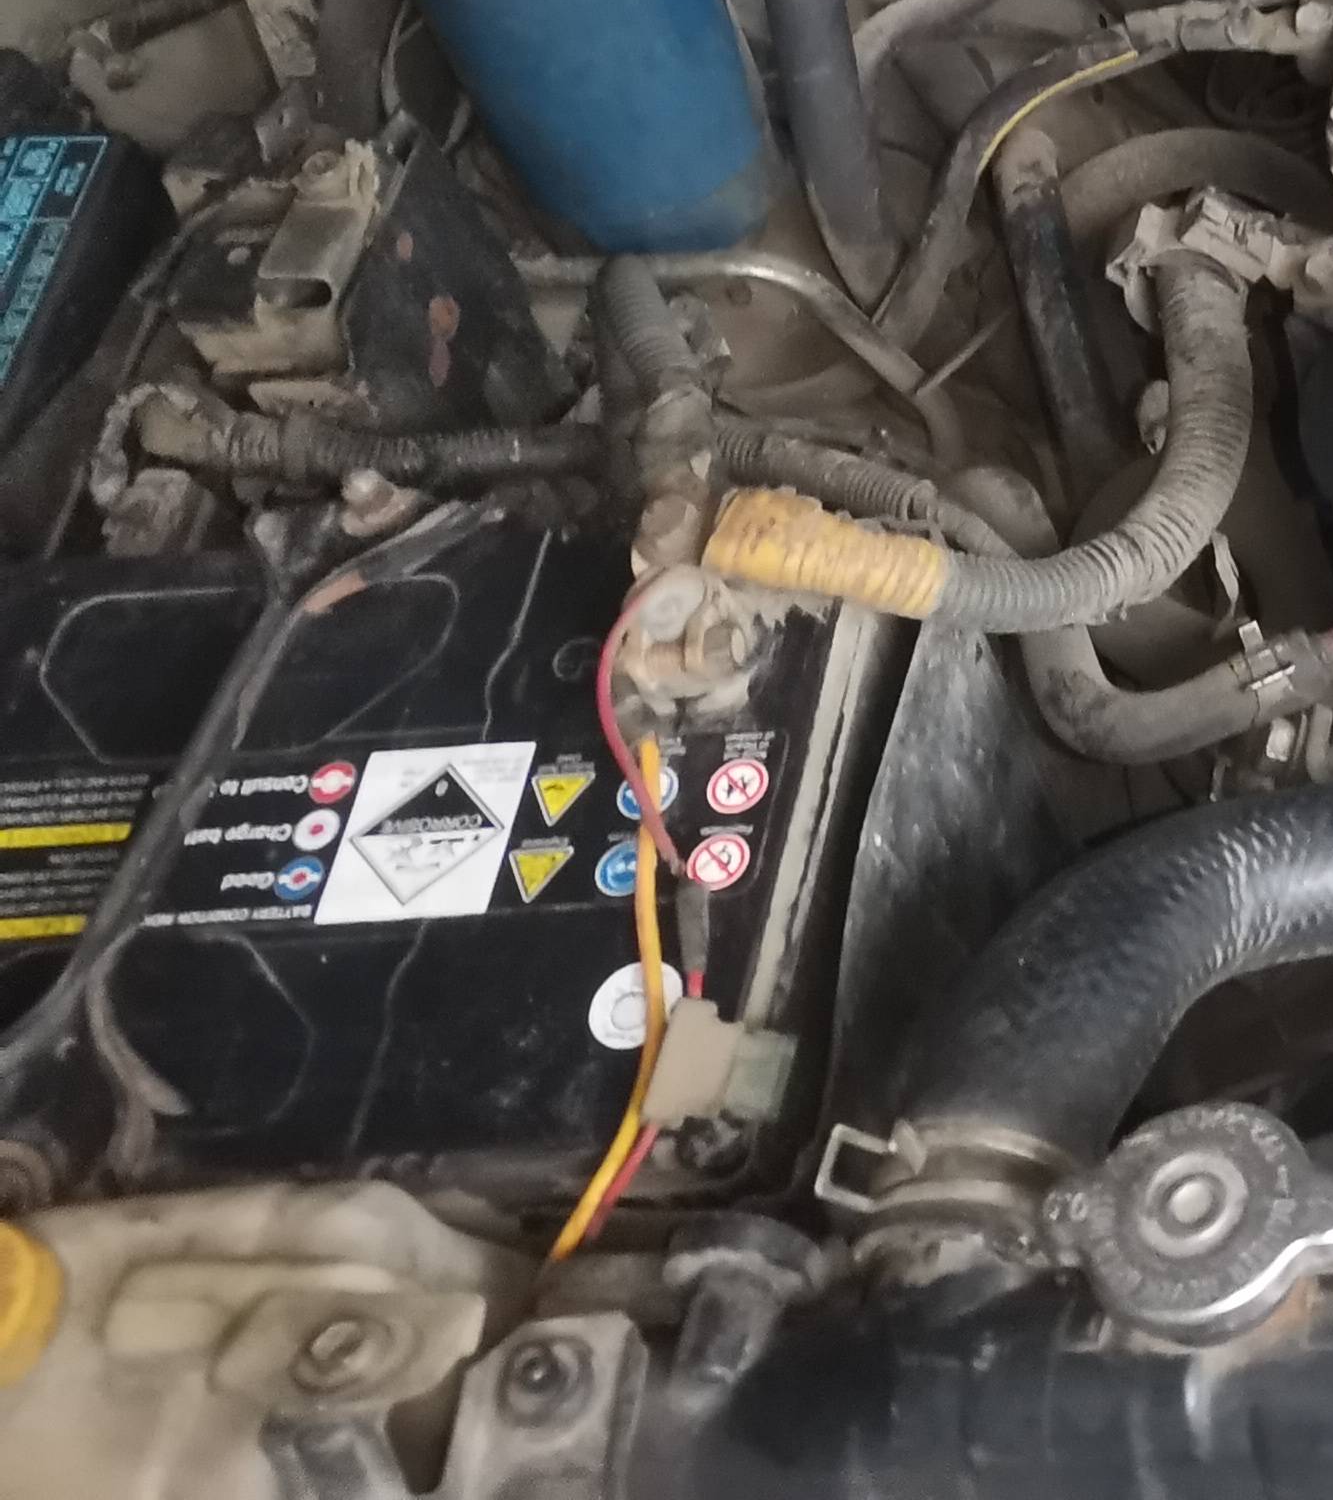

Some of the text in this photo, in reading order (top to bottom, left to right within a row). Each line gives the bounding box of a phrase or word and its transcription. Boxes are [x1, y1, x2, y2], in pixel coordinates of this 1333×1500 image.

[240, 775, 308, 795] Consult
[225, 823, 292, 842] Charge
[220, 872, 275, 891] Good
[177, 908, 249, 924] CONDITION
[252, 905, 312, 919] BATTERY
